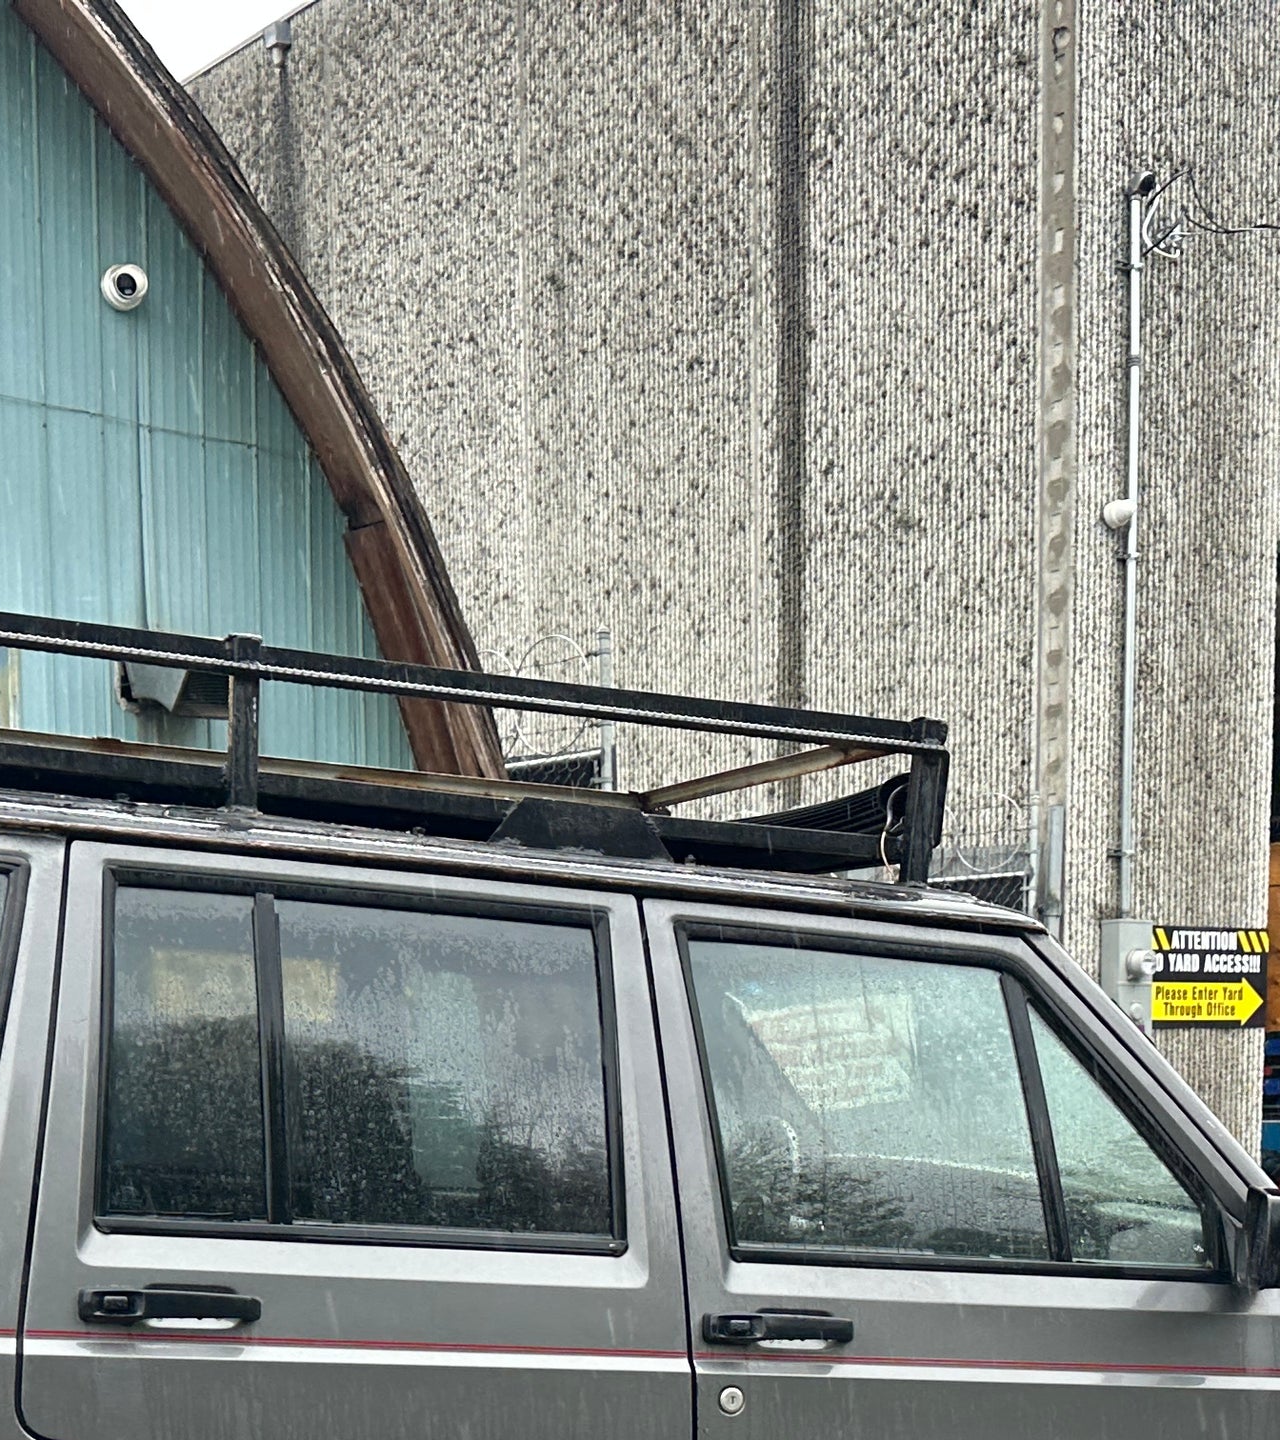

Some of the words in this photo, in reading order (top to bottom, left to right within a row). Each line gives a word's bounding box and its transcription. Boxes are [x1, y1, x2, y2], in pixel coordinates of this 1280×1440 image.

[1170, 930, 1238, 951] ATTENTION
[1167, 953, 1201, 973] YARD
[1203, 954, 1261, 974] ACCESS!!!
[1154, 985, 1189, 1001] Please
[1191, 986, 1219, 1001] Enter
[1221, 986, 1244, 1001] Yard
[1163, 1001, 1203, 1018] Through
[1206, 1002, 1236, 1016] Office
